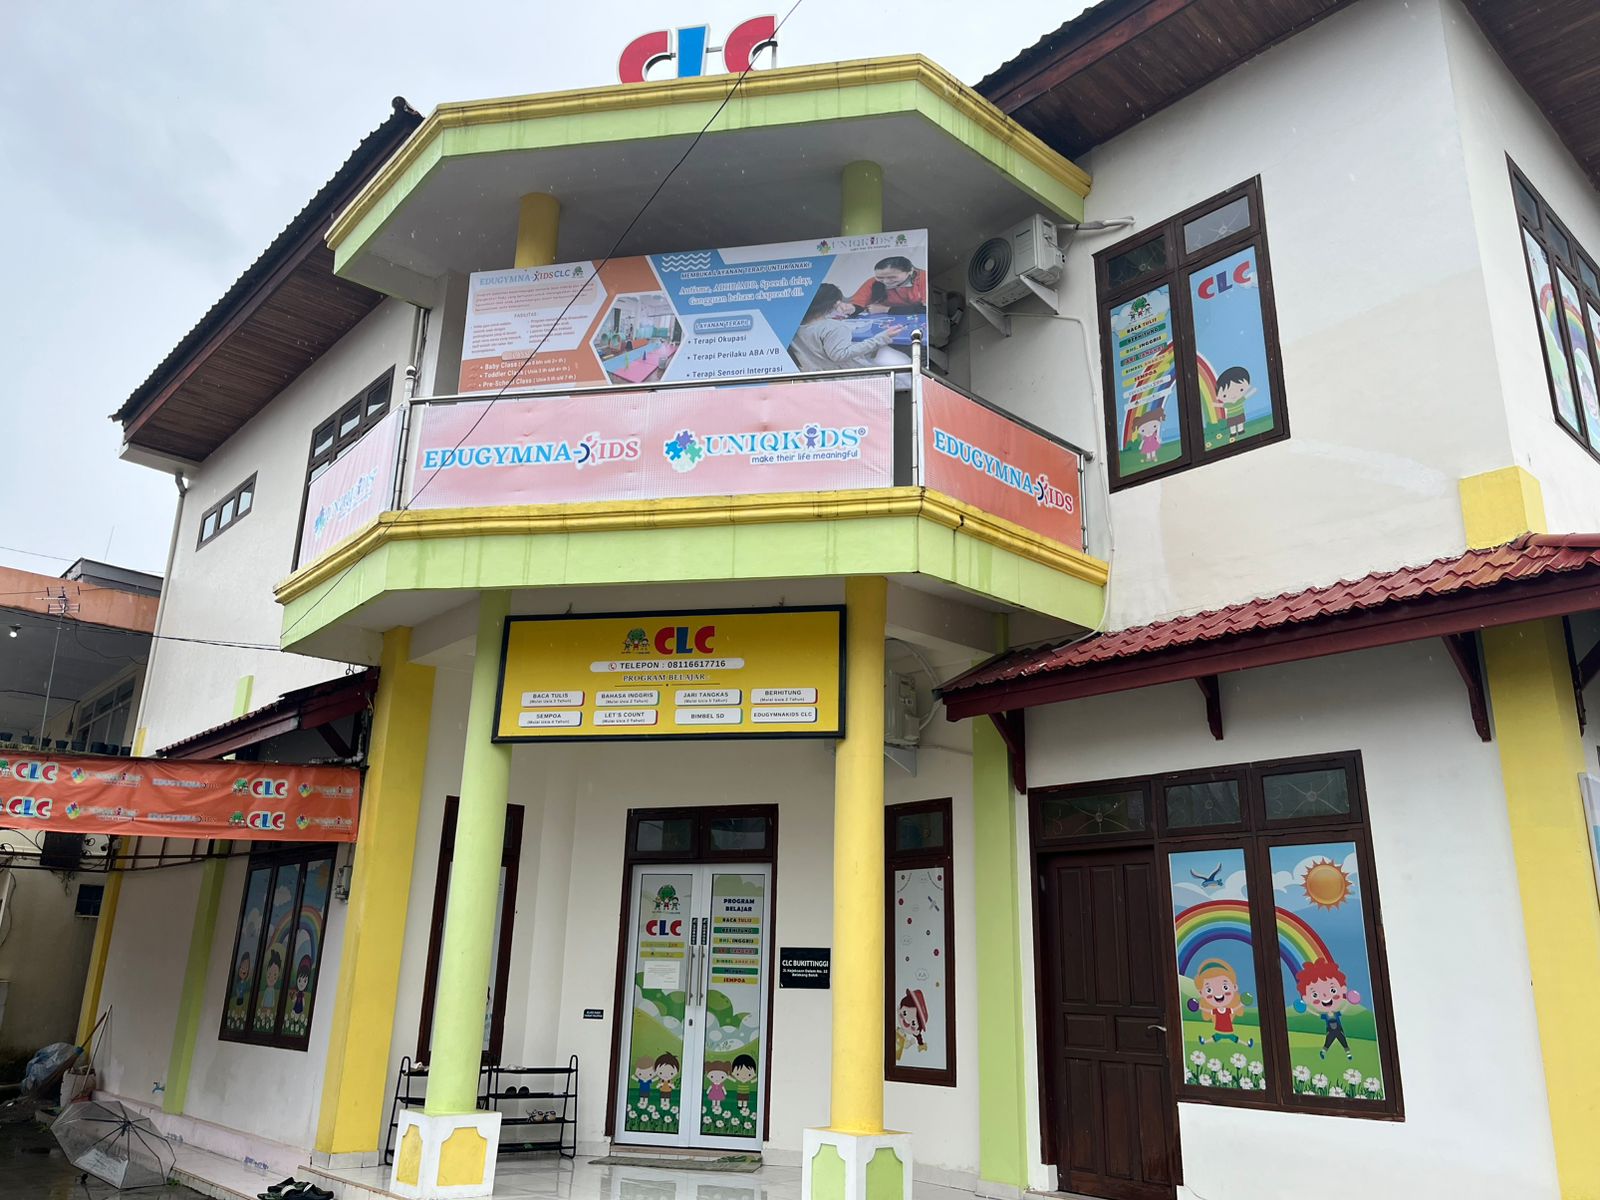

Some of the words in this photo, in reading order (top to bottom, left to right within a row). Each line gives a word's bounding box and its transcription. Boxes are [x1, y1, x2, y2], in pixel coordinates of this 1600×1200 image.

[681, 271, 712, 279] MEMBUKA
[1198, 261, 1251, 300] CLC
[1126, 325, 1141, 334] BACA
[694, 336, 716, 345] Terapi
[717, 334, 747, 343] Okupasi
[693, 352, 716, 361] Terapi
[717, 350, 747, 359] Perilaku
[749, 348, 764, 357] ABA
[484, 362, 499, 371] Baby
[500, 360, 517, 369] Class
[692, 370, 716, 379] Terapi
[717, 367, 745, 377] Sensori
[747, 364, 783, 375] Intergrasi
[484, 370, 506, 379] Toddler
[516, 377, 532, 385] Class
[751, 454, 774, 464] make
[776, 452, 795, 462] their
[797, 450, 811, 461] life
[813, 449, 858, 461] meaningful
[654, 626, 716, 655] CLC
[620, 662, 659, 670] TELEPON
[667, 660, 726, 669] 08116617716
[623, 674, 666, 682] PROGRAM
[668, 673, 705, 681] BELAJAR
[15, 762, 56, 781] CLC
[252, 780, 286, 796] CLC
[9, 799, 50, 817] CLC
[249, 813, 284, 828] CLC
[645, 919, 682, 936] CLC
[781, 959, 793, 967] CLC
